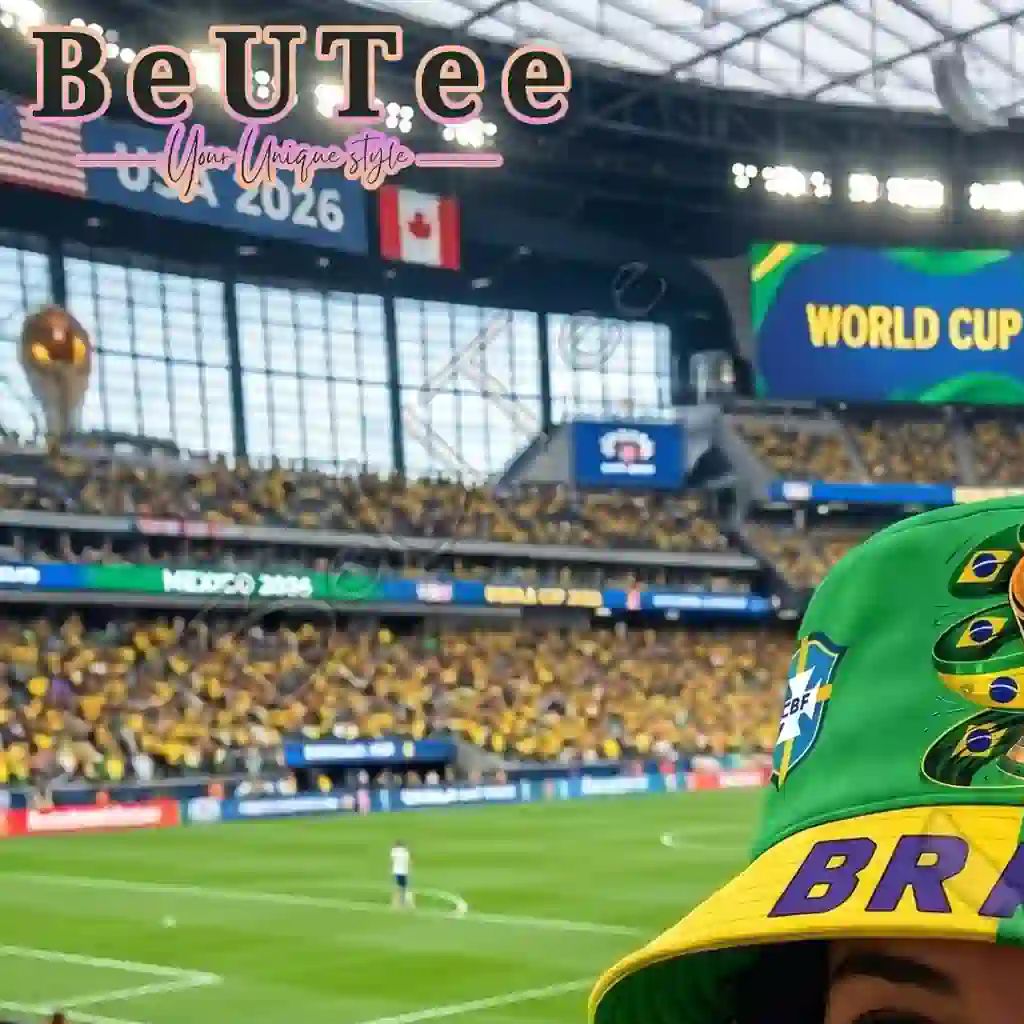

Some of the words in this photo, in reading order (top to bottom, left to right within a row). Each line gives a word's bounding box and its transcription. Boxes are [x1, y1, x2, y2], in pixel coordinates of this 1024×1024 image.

[114, 142, 219, 208] UA
[234, 174, 344, 233] 2026
[805, 301, 941, 350] WORLD
[947, 305, 1024, 351] CUP
